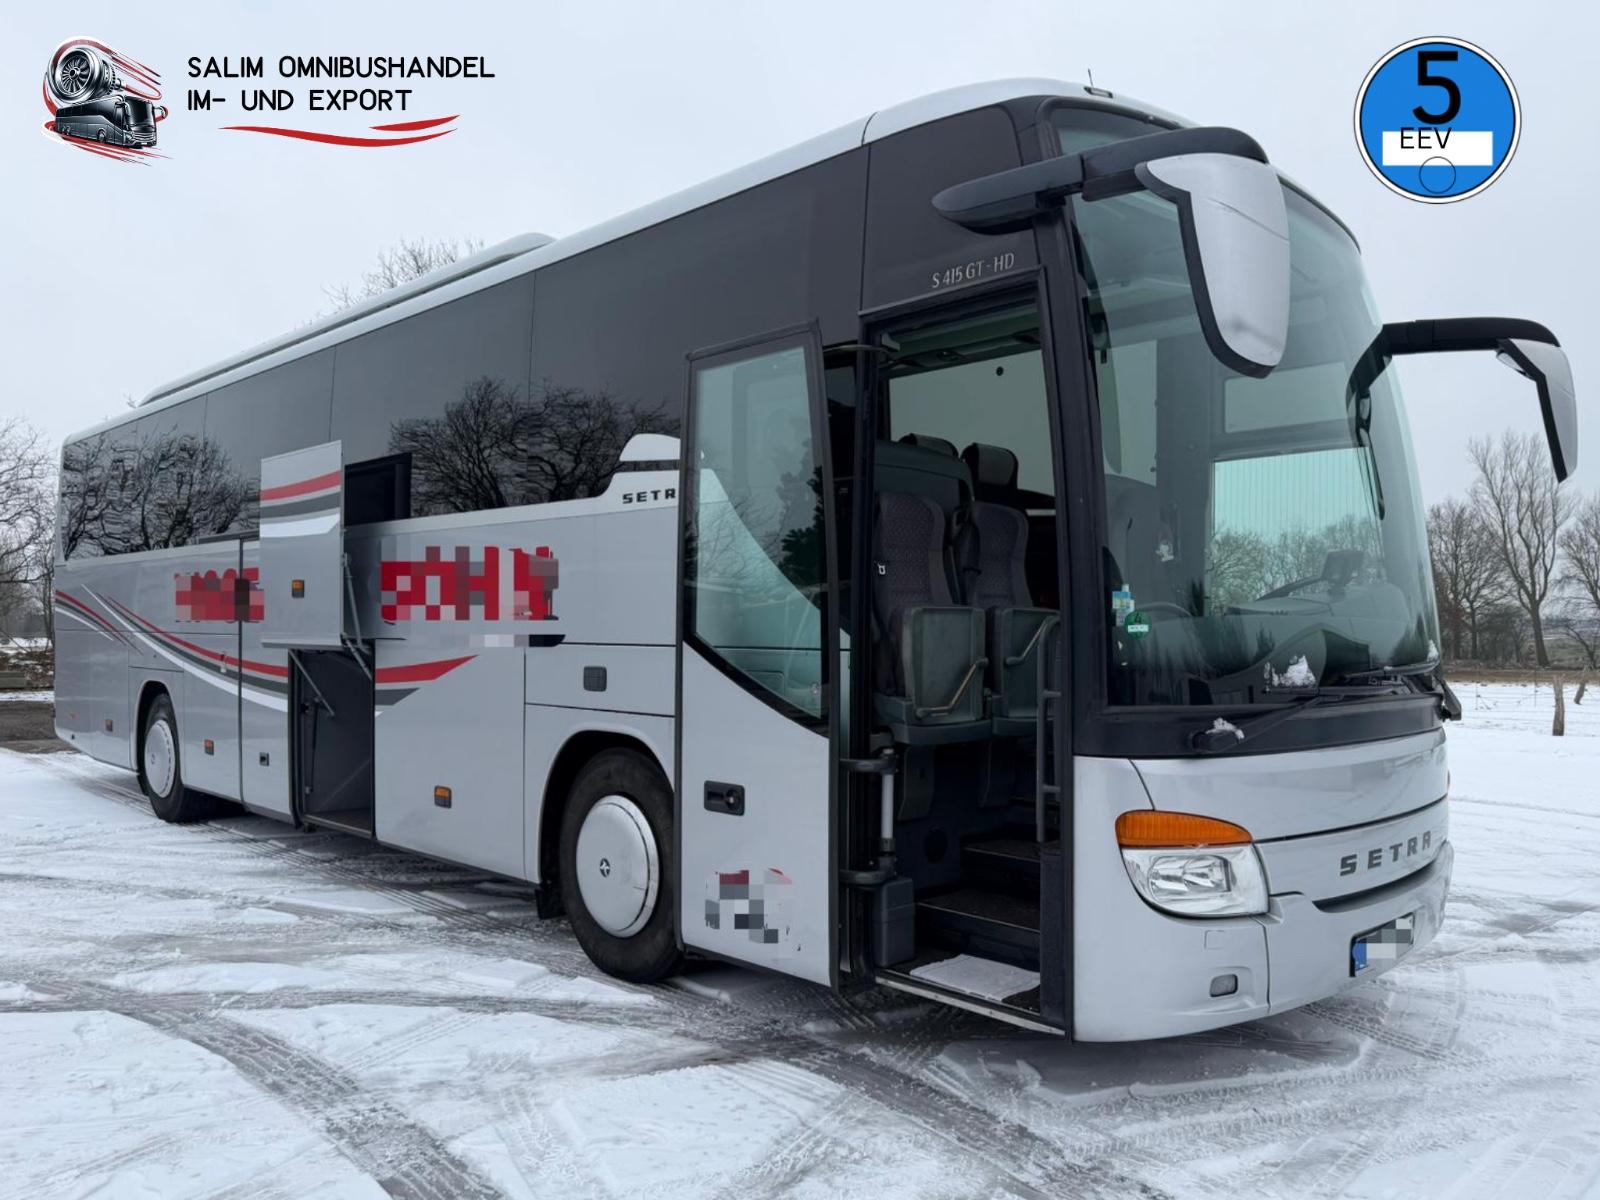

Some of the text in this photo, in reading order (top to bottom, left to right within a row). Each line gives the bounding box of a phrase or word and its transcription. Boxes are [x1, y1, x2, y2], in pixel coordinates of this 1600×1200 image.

[932, 272, 940, 288] S
[942, 265, 963, 286] 415
[622, 488, 677, 504] SETR
[1339, 830, 1432, 877] SETRA
